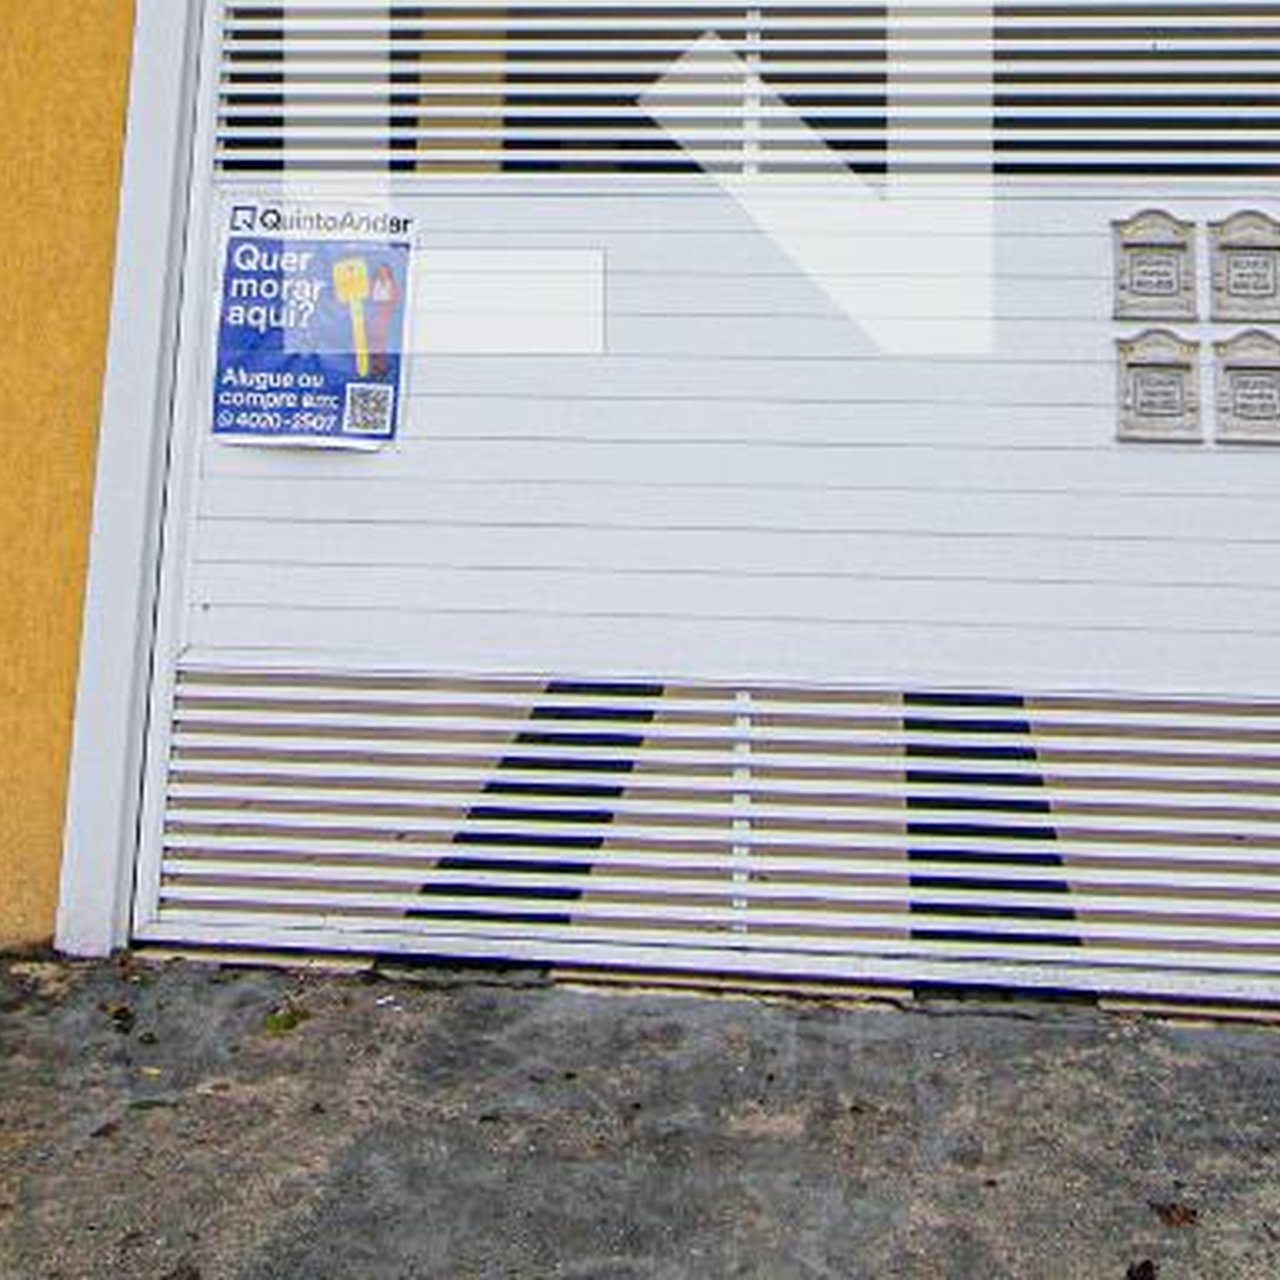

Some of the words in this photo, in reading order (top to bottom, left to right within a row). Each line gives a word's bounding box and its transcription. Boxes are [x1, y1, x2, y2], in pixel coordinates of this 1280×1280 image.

[235, 244, 311, 272] Quer
[231, 276, 322, 301] morar
[228, 299, 314, 333] aqui?
[222, 369, 293, 391] Alugue
[297, 374, 324, 388] ou
[219, 391, 296, 409] compre
